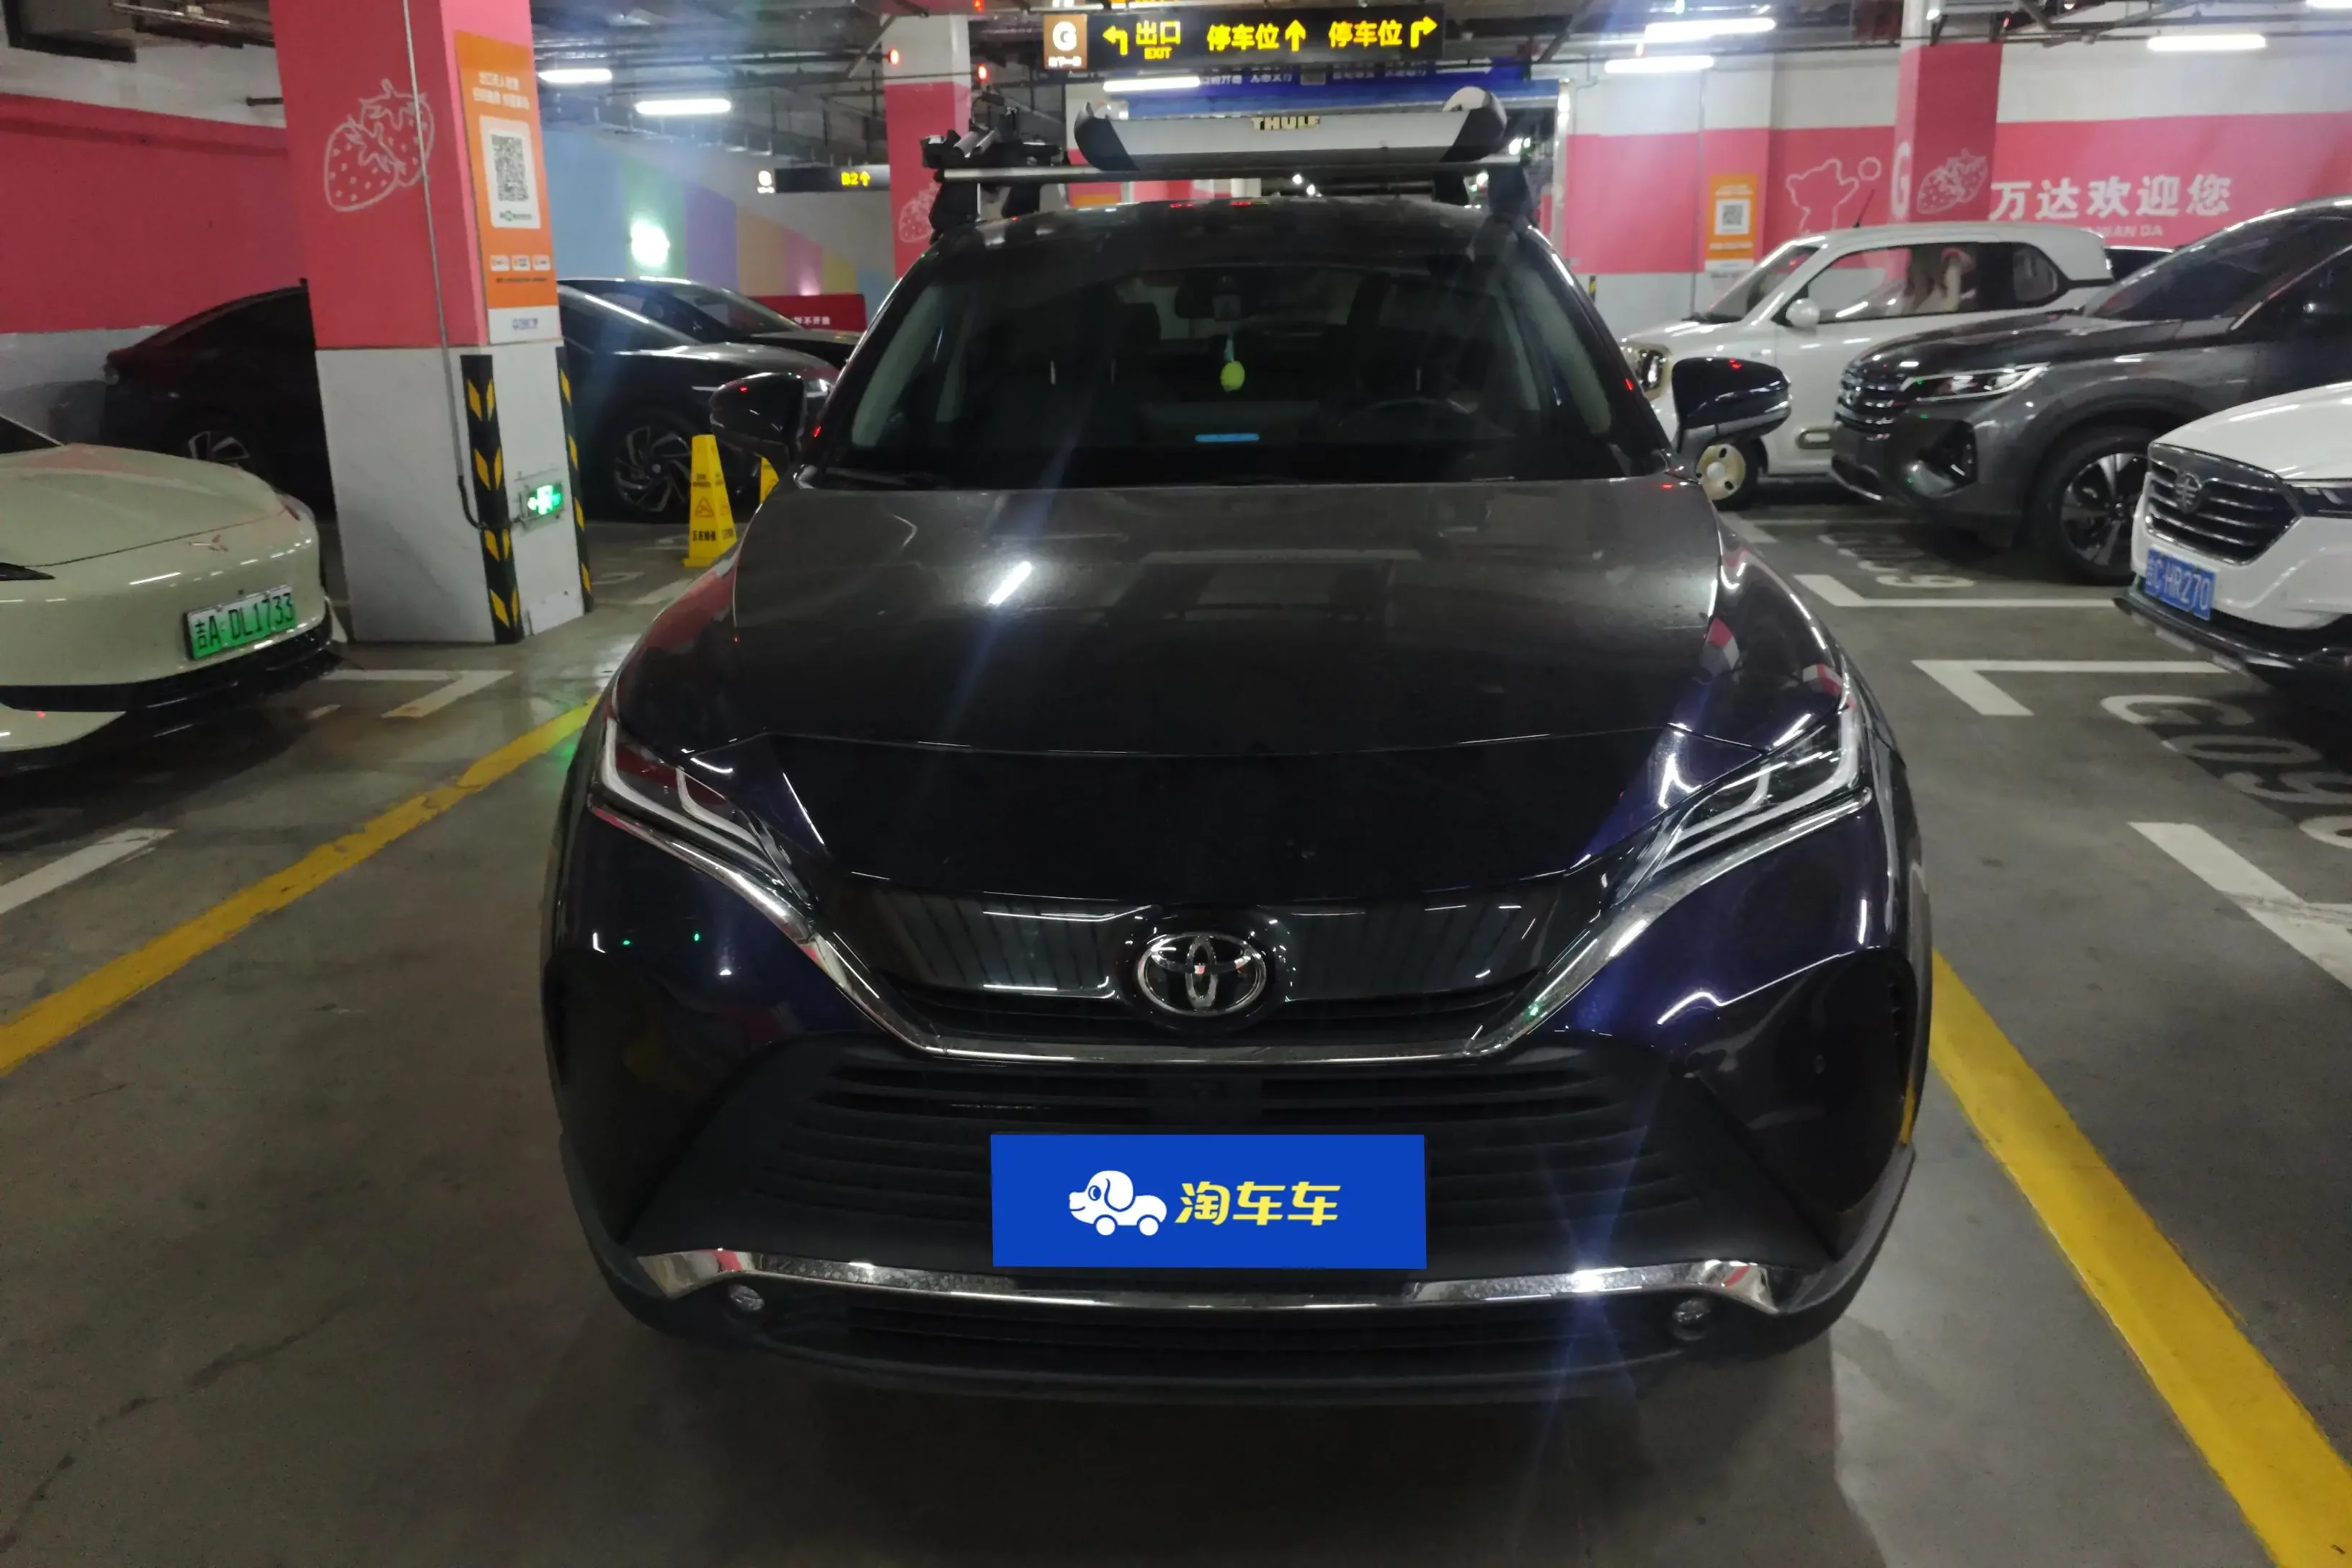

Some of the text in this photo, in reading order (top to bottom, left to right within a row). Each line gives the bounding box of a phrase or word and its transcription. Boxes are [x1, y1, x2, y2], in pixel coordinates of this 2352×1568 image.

[1052, 21, 1077, 51] G
[1136, 19, 1181, 45] 出口
[1207, 23, 1279, 51] 停车位
[1329, 19, 1403, 48] 停车位
[1144, 47, 1172, 59] EXIT
[1987, 174, 2232, 222] 万达欢迎您
